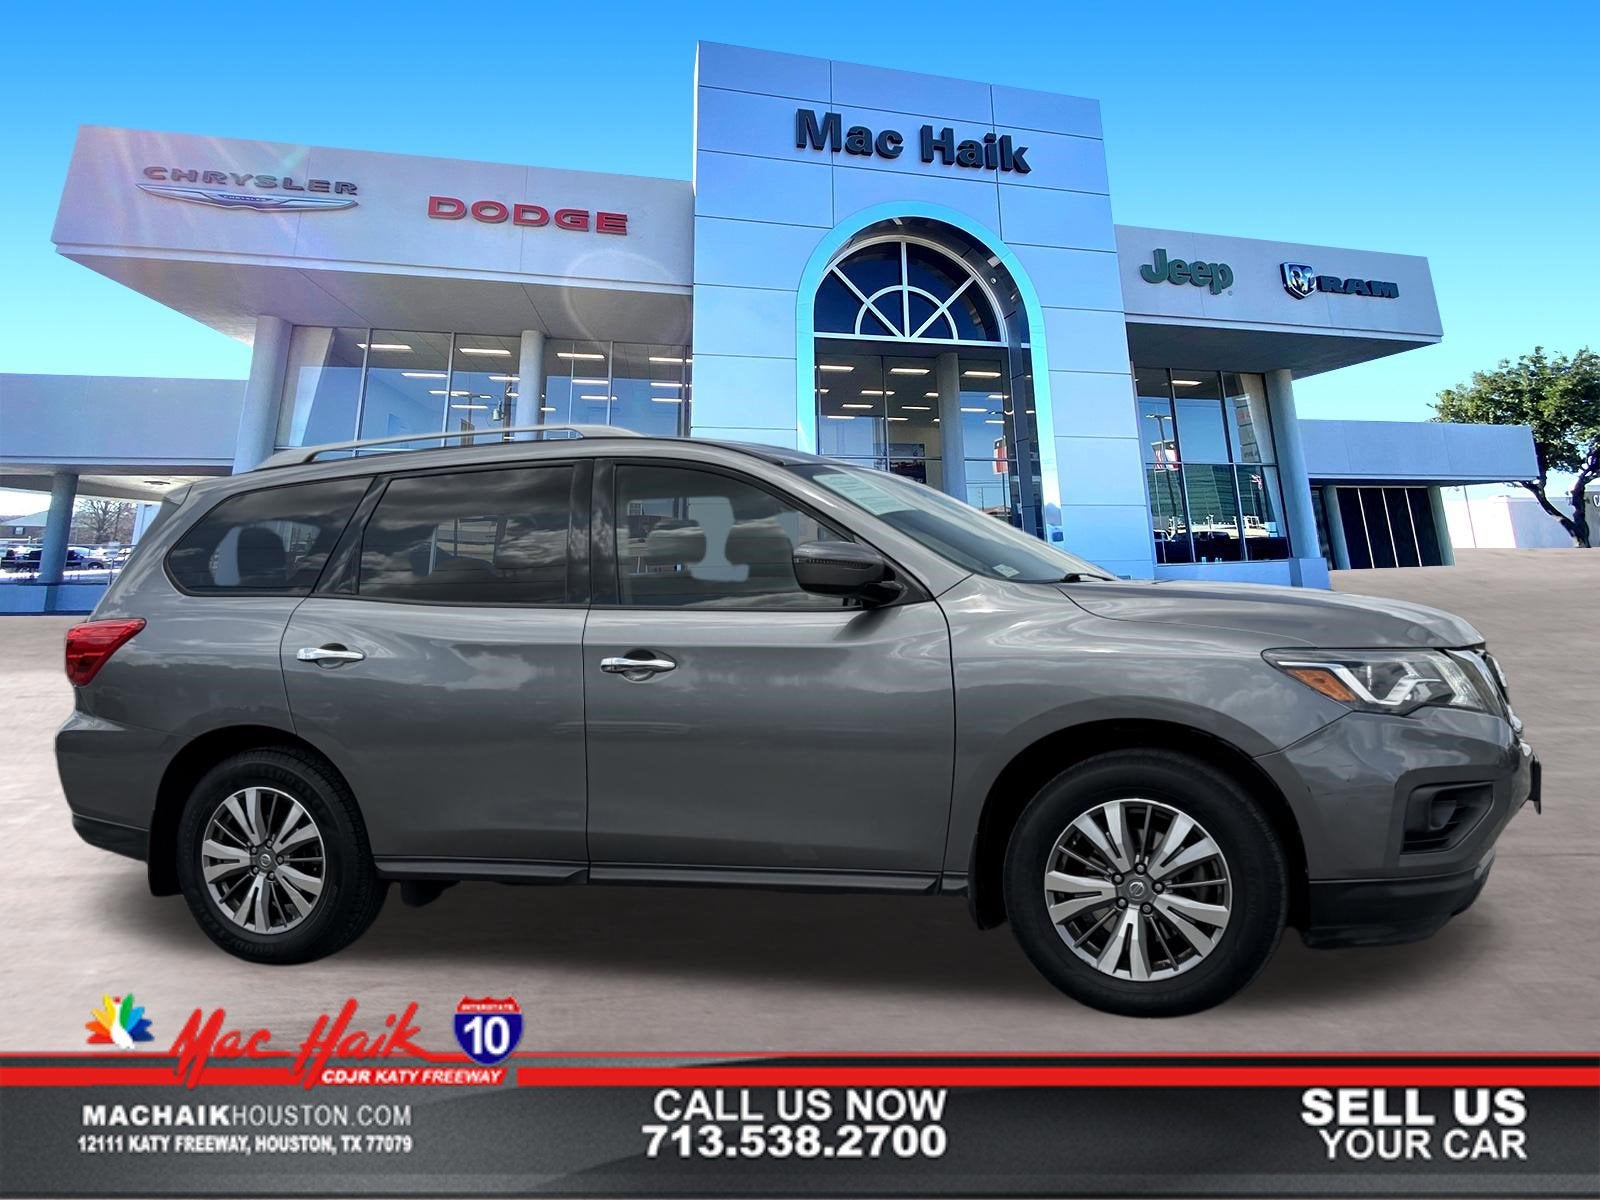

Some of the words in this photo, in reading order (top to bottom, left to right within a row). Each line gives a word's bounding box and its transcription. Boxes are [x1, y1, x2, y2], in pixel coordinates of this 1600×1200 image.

[796, 108, 904, 159] Mac
[919, 124, 1032, 174] Haik
[143, 166, 358, 196] CHRYSLER
[428, 196, 628, 236] DODGE
[1139, 248, 1234, 296] Jeep
[1316, 275, 1400, 299] RAM
